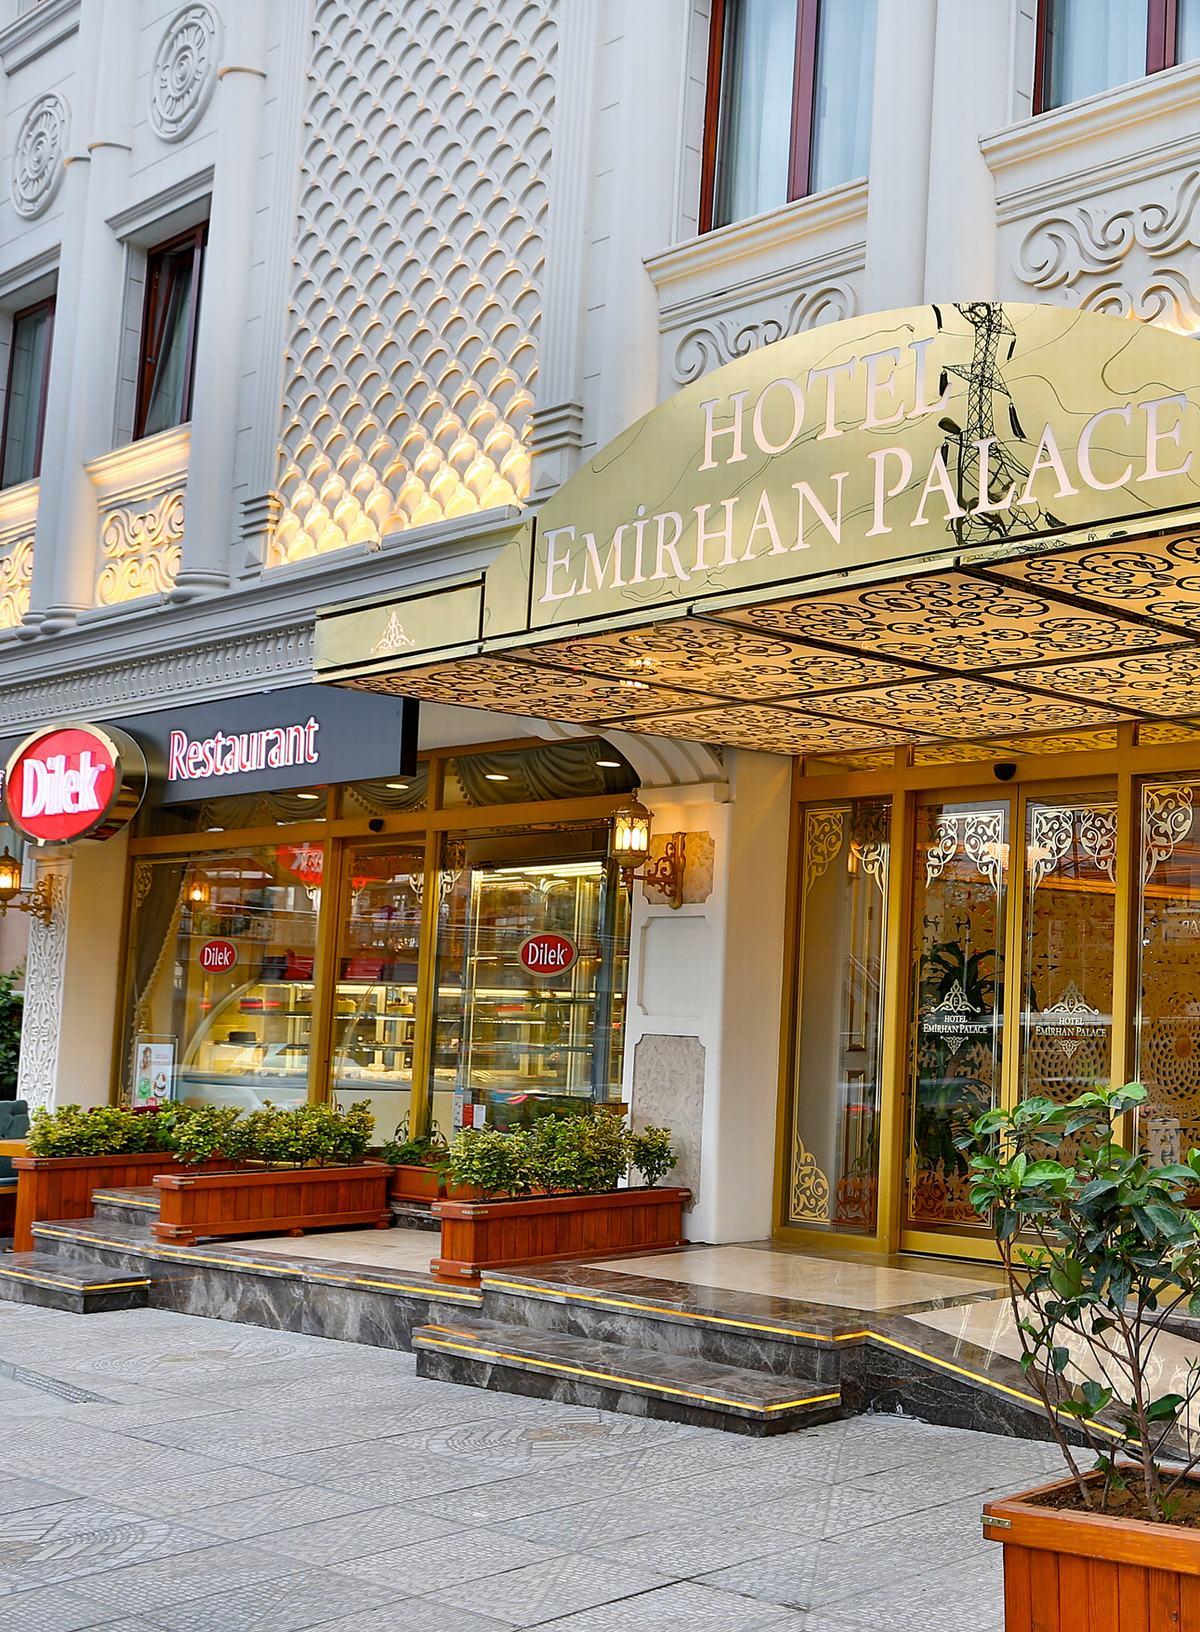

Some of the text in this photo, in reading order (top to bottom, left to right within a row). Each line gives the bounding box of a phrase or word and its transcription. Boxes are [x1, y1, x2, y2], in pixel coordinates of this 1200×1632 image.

[698, 337, 952, 472] HOTEL
[539, 393, 1193, 603] EMİRHAN PALACE
[168, 716, 319, 781] Restaurant
[22, 751, 106, 817] Dilek
[204, 946, 231, 966] Dilek
[528, 942, 567, 965] Dilek
[944, 1015, 968, 1023] HOTEL
[959, 1024, 988, 1034] PALACE
[1058, 1017, 1084, 1026] HOTEL
[1076, 1026, 1107, 1037] PALACE
